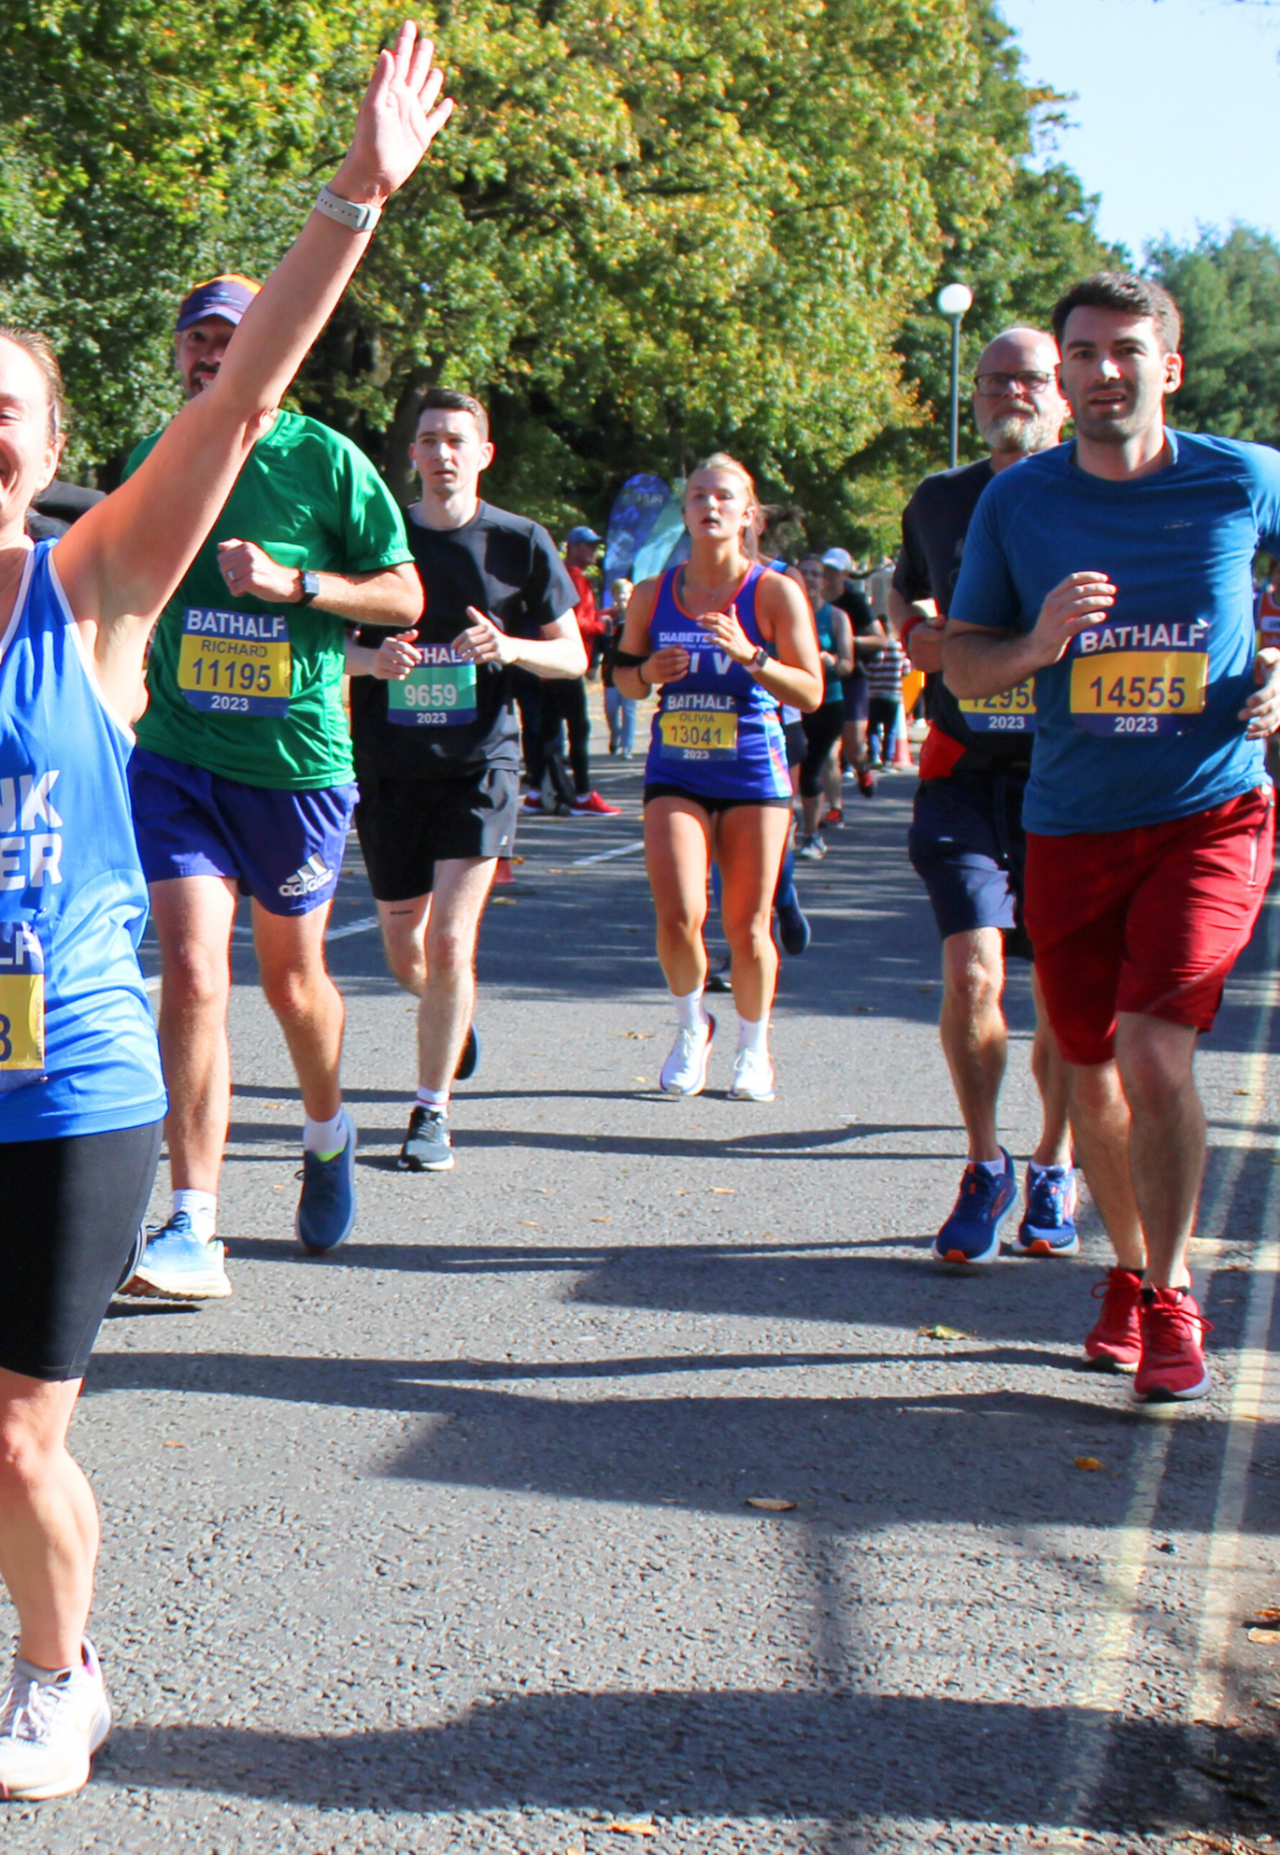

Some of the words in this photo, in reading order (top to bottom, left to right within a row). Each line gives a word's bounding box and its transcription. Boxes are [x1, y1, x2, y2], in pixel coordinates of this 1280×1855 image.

[187, 610, 285, 638] BATHALF
[1081, 623, 1204, 653] BATHALF
[201, 639, 268, 658] RICHARD
[192, 657, 271, 692] 11195
[404, 684, 458, 707] 9659
[1090, 676, 1185, 708] 14555
[210, 695, 249, 711] 2023
[668, 694, 736, 710] BATHALF
[416, 713, 447, 723] 2023
[679, 713, 716, 723] OLIVIA
[988, 715, 1025, 729] 2023
[1114, 716, 1158, 732] 2023
[671, 725, 722, 746] 13041
[683, 748, 710, 760] 2023
